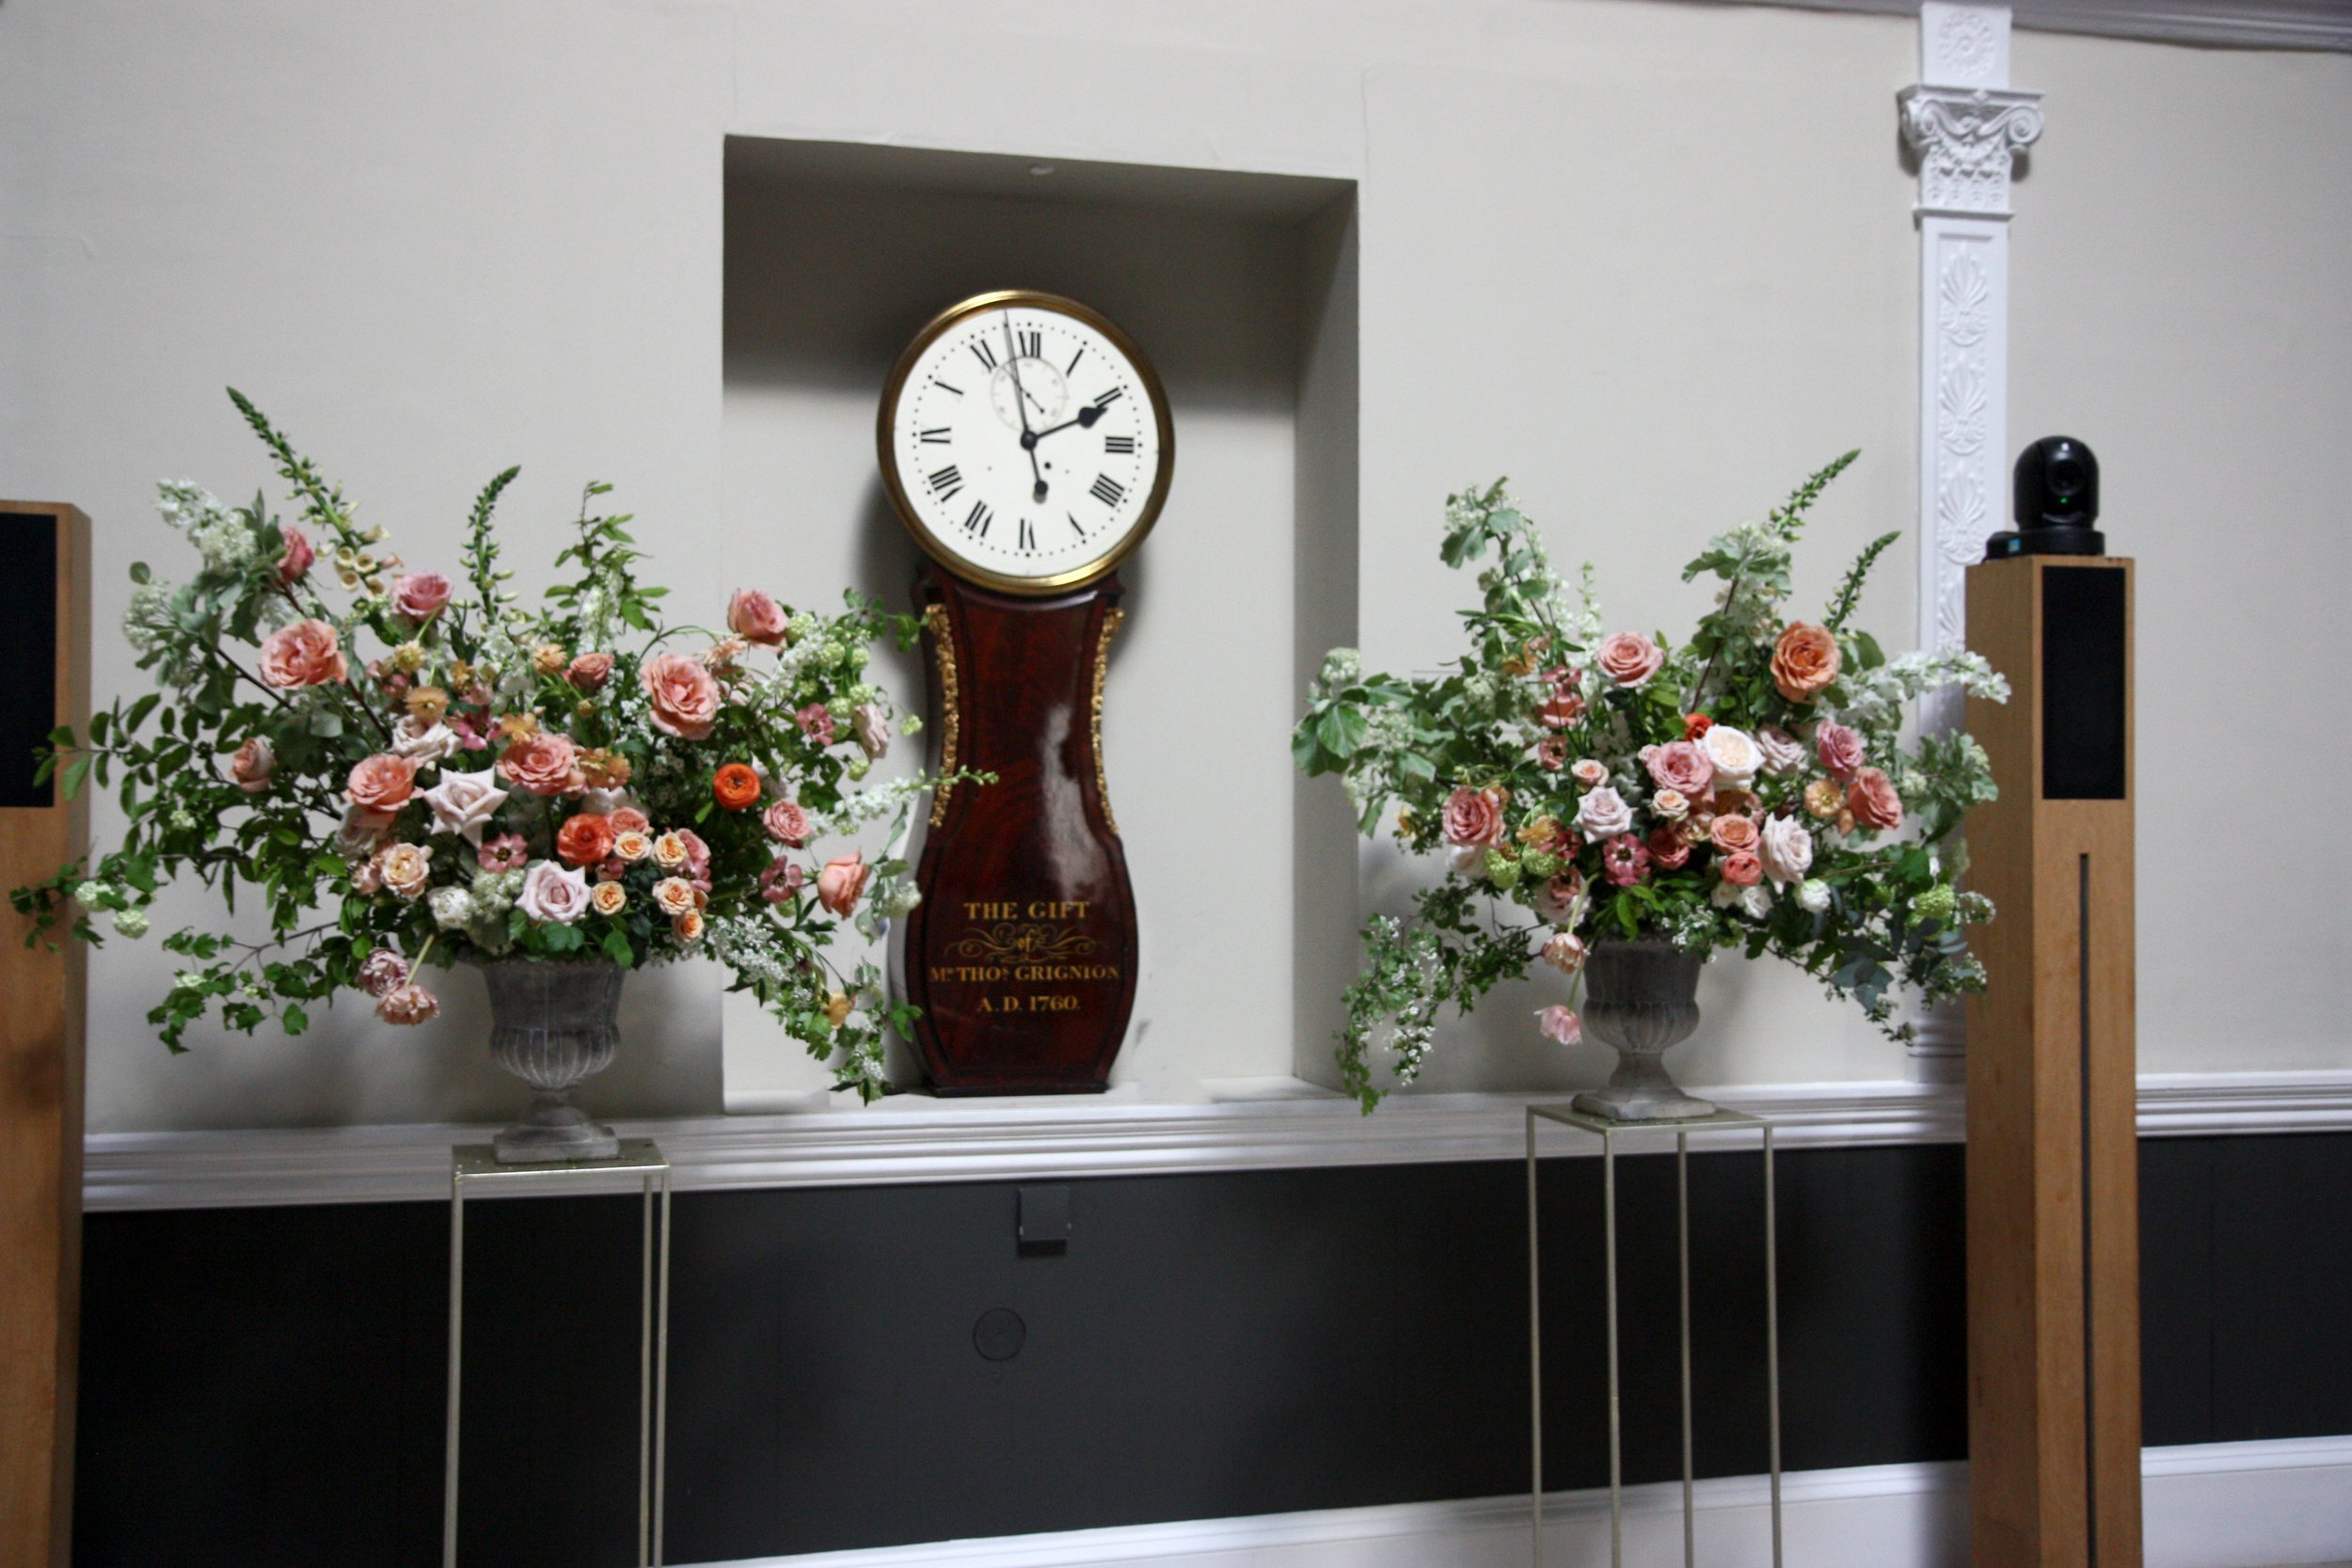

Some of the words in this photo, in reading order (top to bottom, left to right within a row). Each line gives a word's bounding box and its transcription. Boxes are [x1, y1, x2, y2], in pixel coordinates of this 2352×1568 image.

[963, 902, 1018, 920] THE
[1027, 901, 1089, 918] GIFT
[1017, 928, 1036, 952] of
[1014, 964, 1120, 981] GRIGNION
